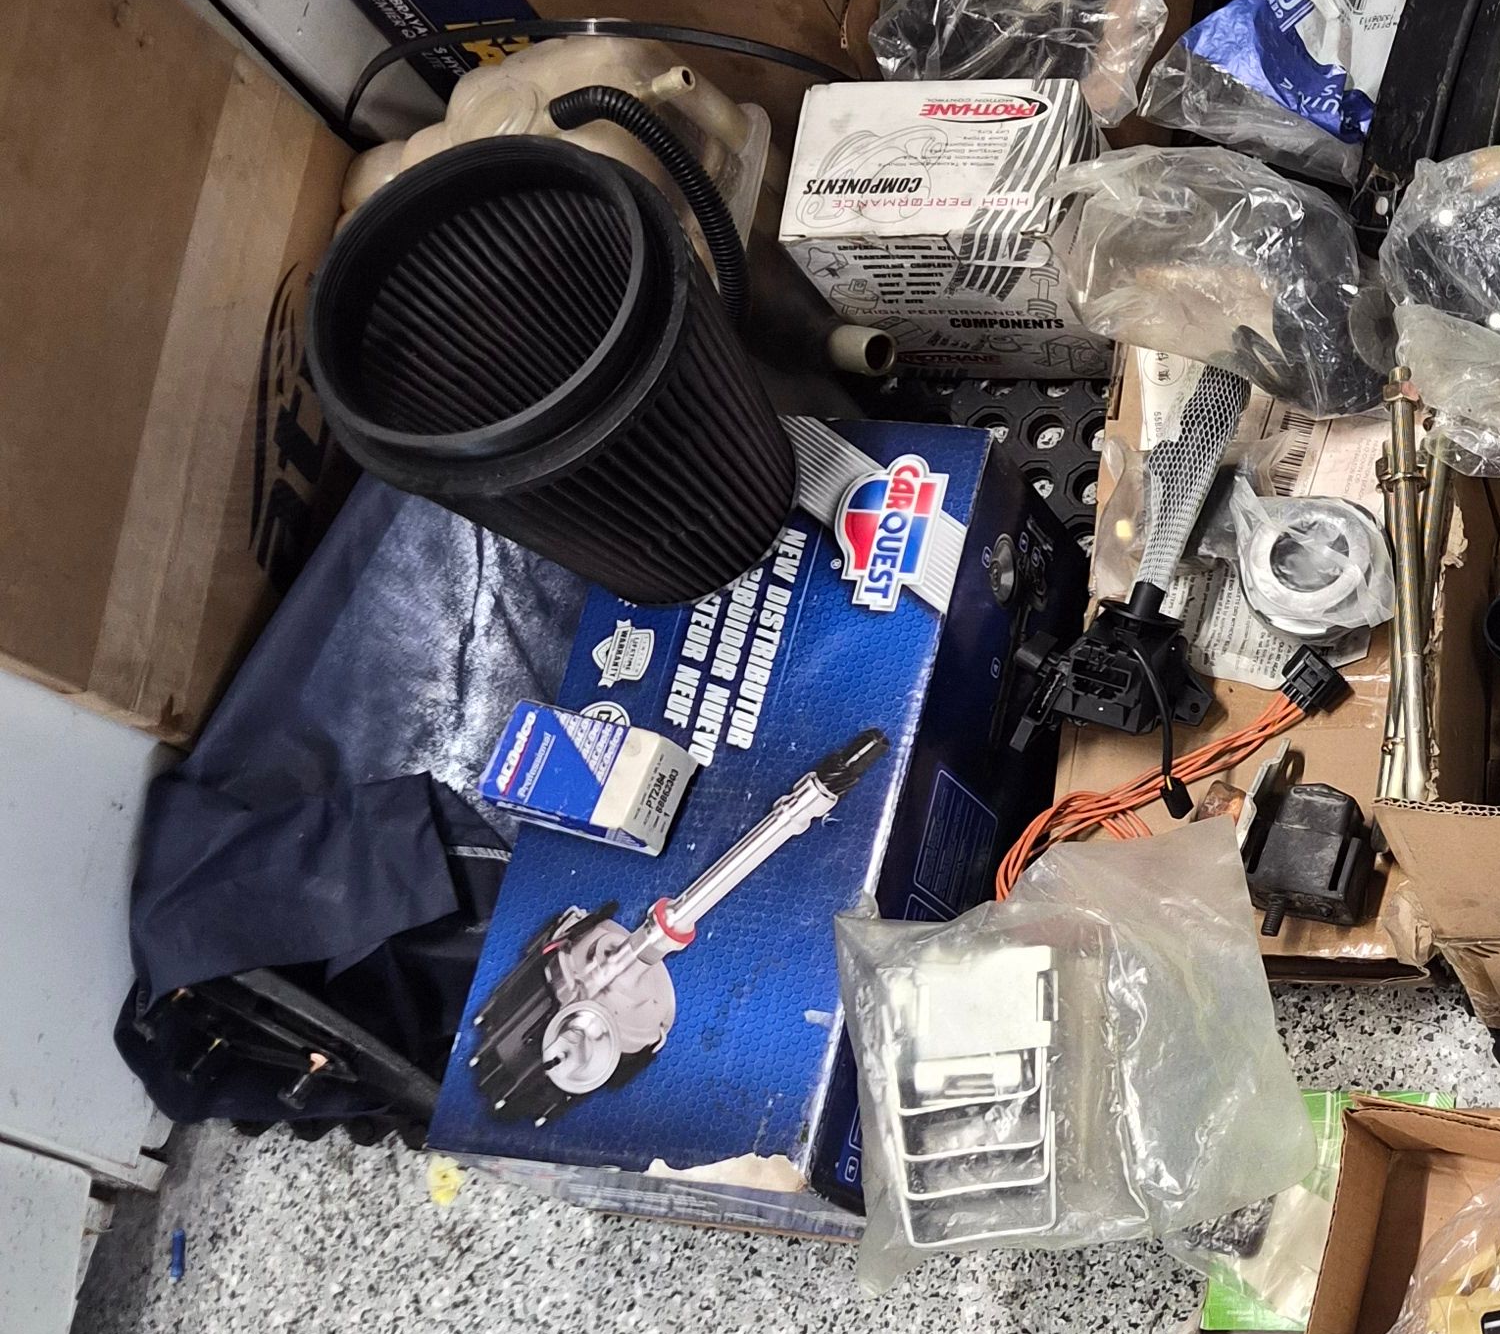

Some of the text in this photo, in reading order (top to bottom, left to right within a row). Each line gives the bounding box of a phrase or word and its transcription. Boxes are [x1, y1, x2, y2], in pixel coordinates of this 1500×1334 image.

[919, 103, 1039, 117] PROTHANE
[803, 176, 924, 195] COMPONENTS
[832, 197, 1029, 209] HIGH PERFORMANCE
[950, 318, 1065, 329] COMPONENTS
[864, 464, 920, 600] CARQUEST
[726, 527, 808, 750] NEW DISTRIBUTOR
[664, 663, 702, 729] NEUF
[687, 682, 731, 768] NUEVO
[496, 711, 538, 793] ACDelco
[516, 731, 553, 798] Professional
